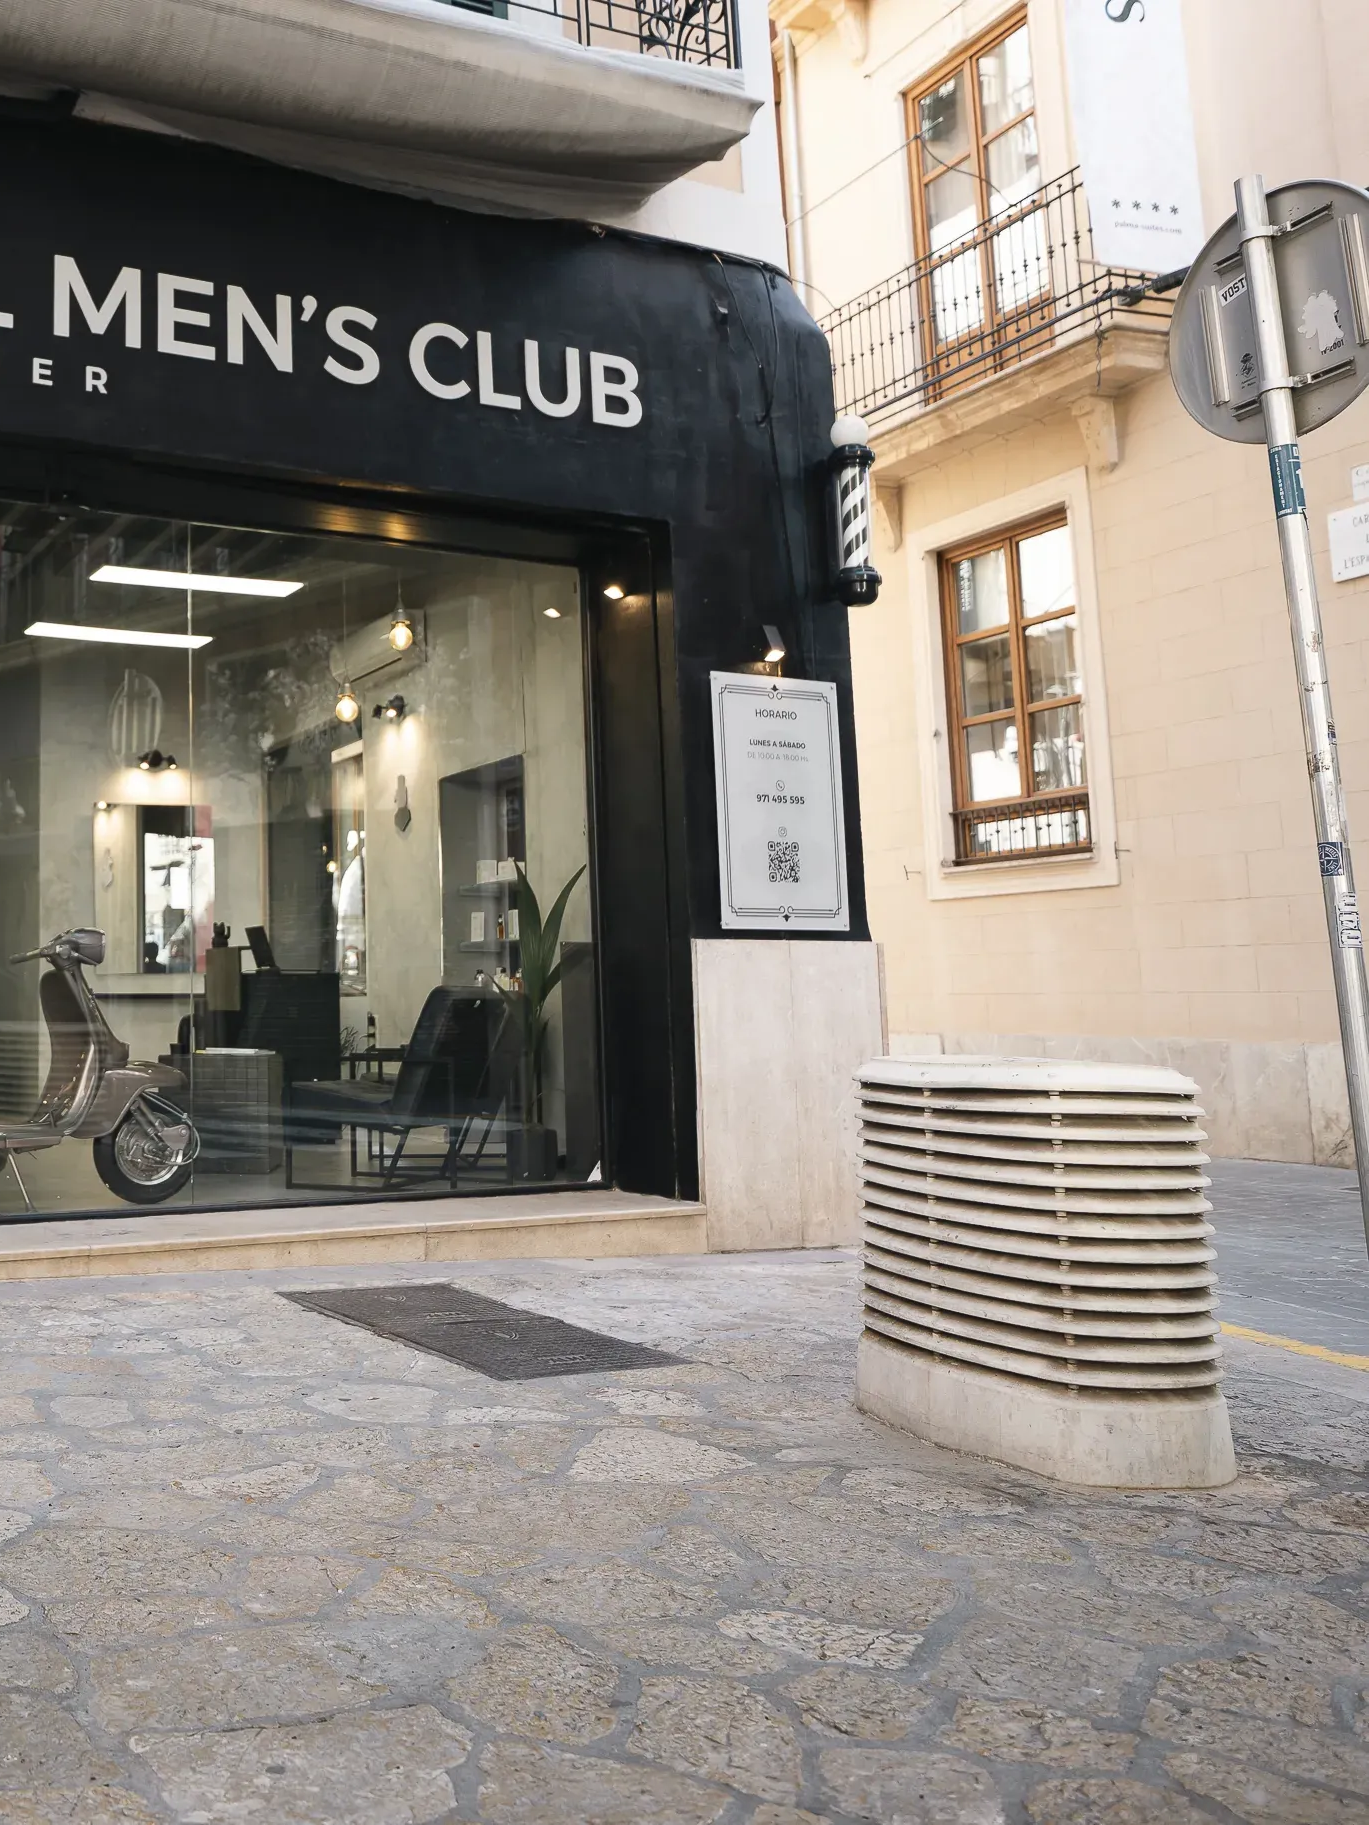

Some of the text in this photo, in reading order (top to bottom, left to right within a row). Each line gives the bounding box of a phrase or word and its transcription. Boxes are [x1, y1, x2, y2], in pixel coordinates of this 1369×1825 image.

[53, 254, 380, 385] MEN'S
[409, 322, 643, 428] CLUB
[755, 708, 797, 720] HORARIO
[749, 738, 771, 747] LUNES
[756, 793, 805, 805] 971 495 595
